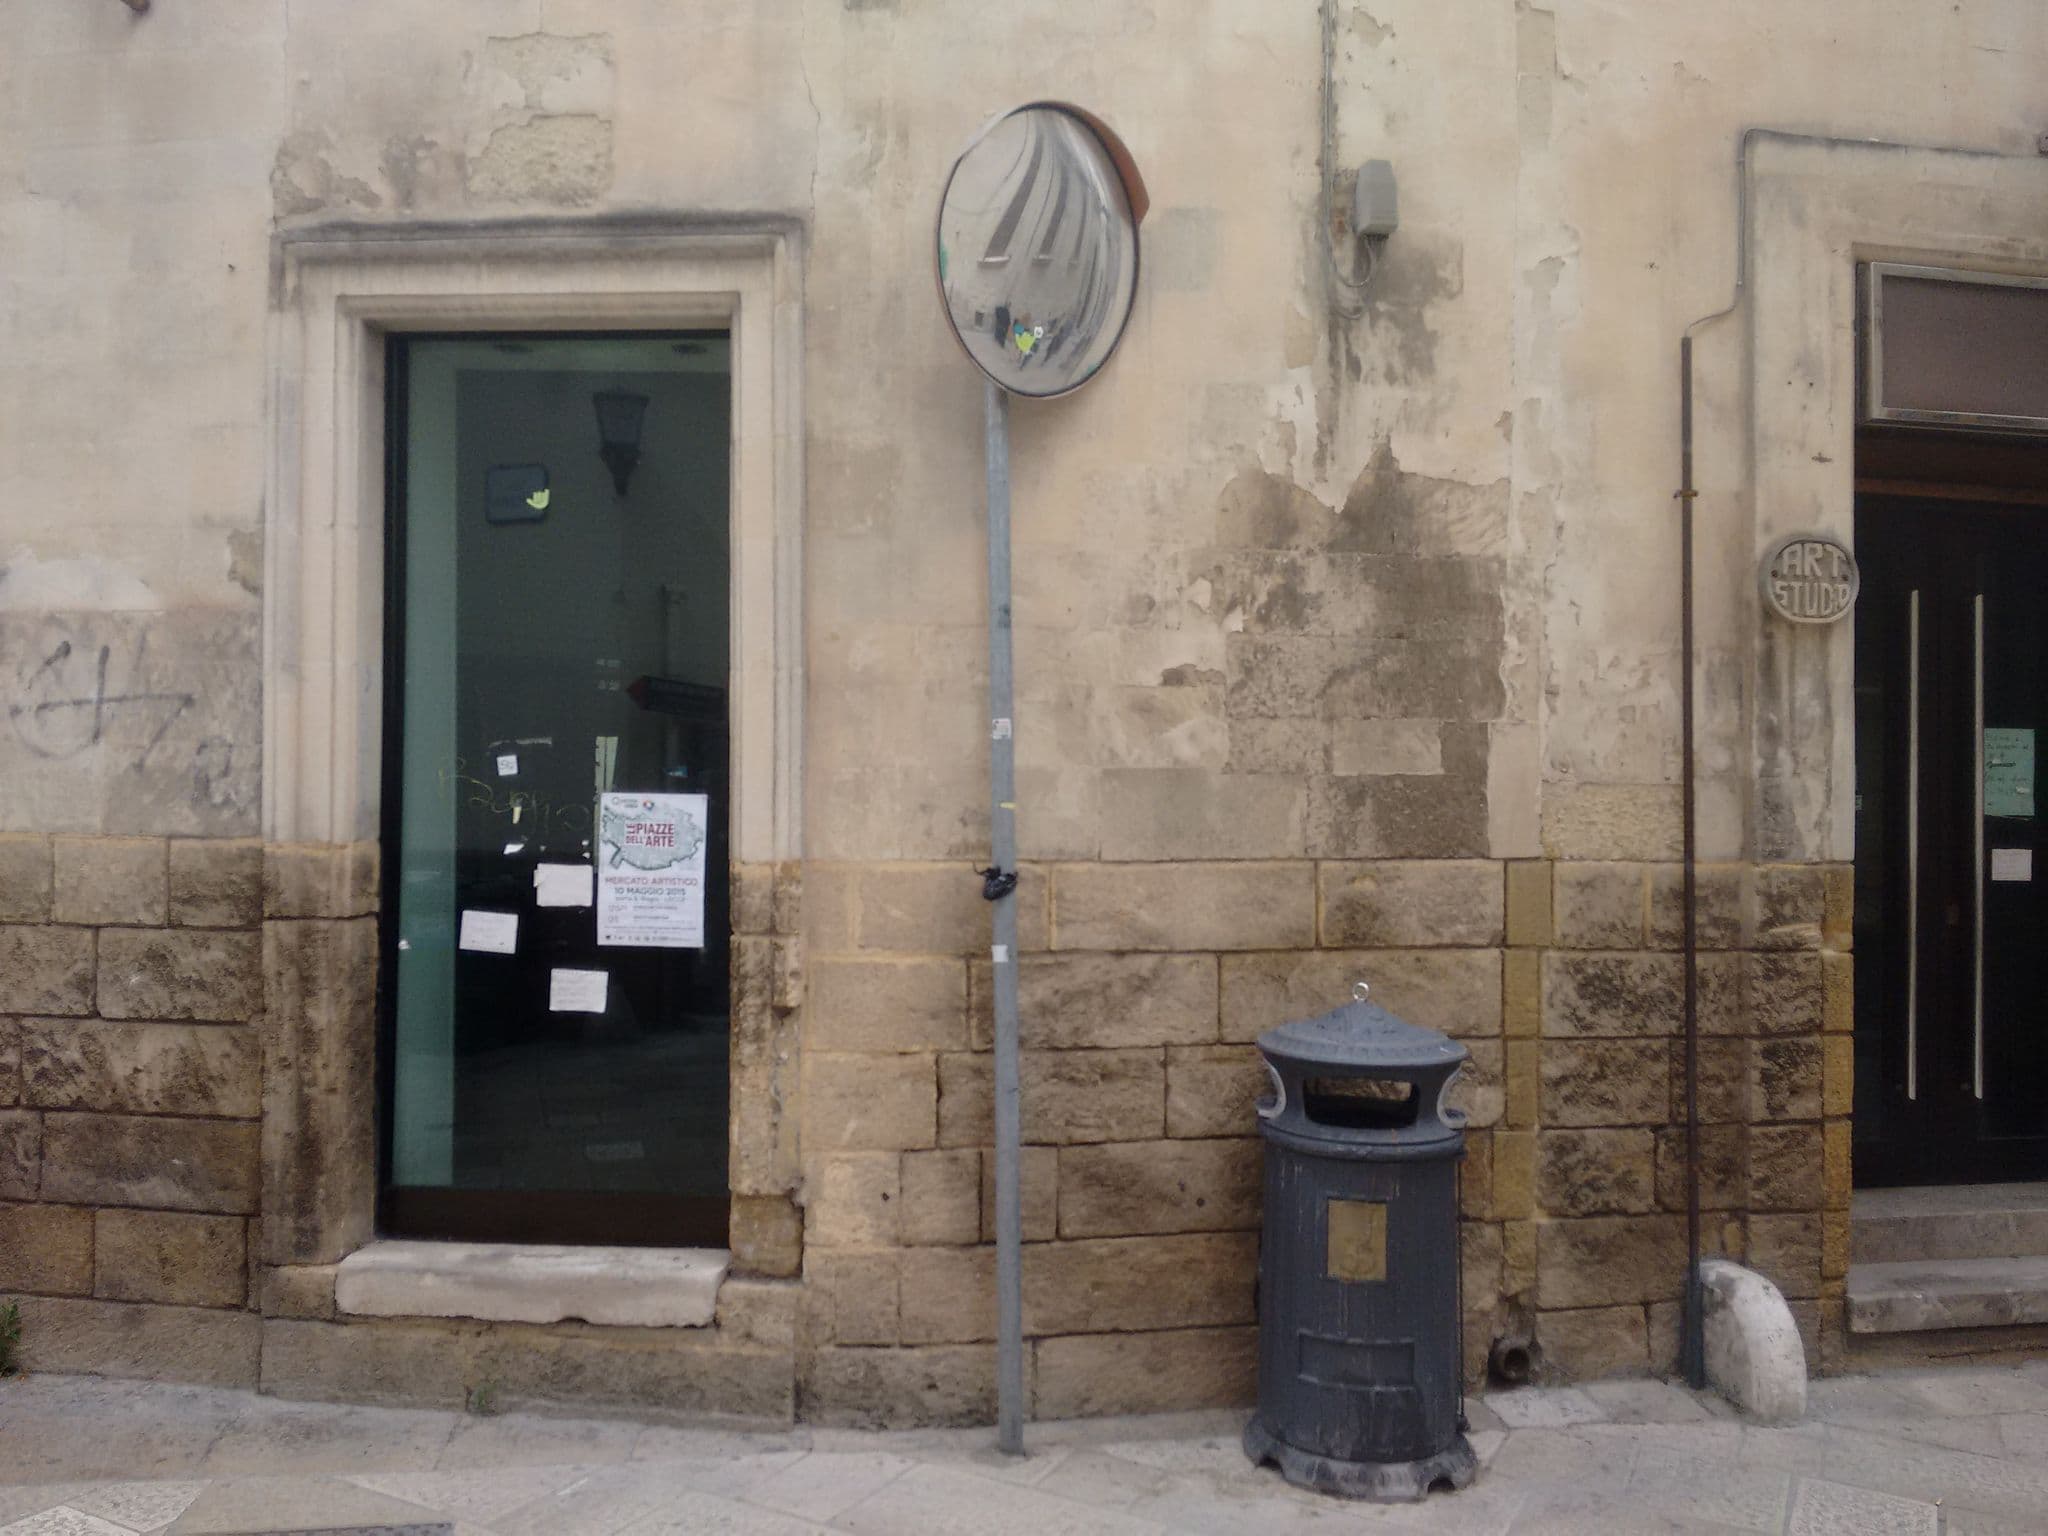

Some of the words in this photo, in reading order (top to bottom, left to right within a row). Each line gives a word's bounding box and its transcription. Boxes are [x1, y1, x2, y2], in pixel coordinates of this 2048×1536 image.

[1782, 543, 1848, 578] ART
[637, 823, 674, 835] PIAZZE
[605, 877, 649, 886] MERCATO
[651, 877, 699, 887] ARTISTICO
[614, 887, 623, 895] 10
[626, 887, 664, 895] MAGGIO
